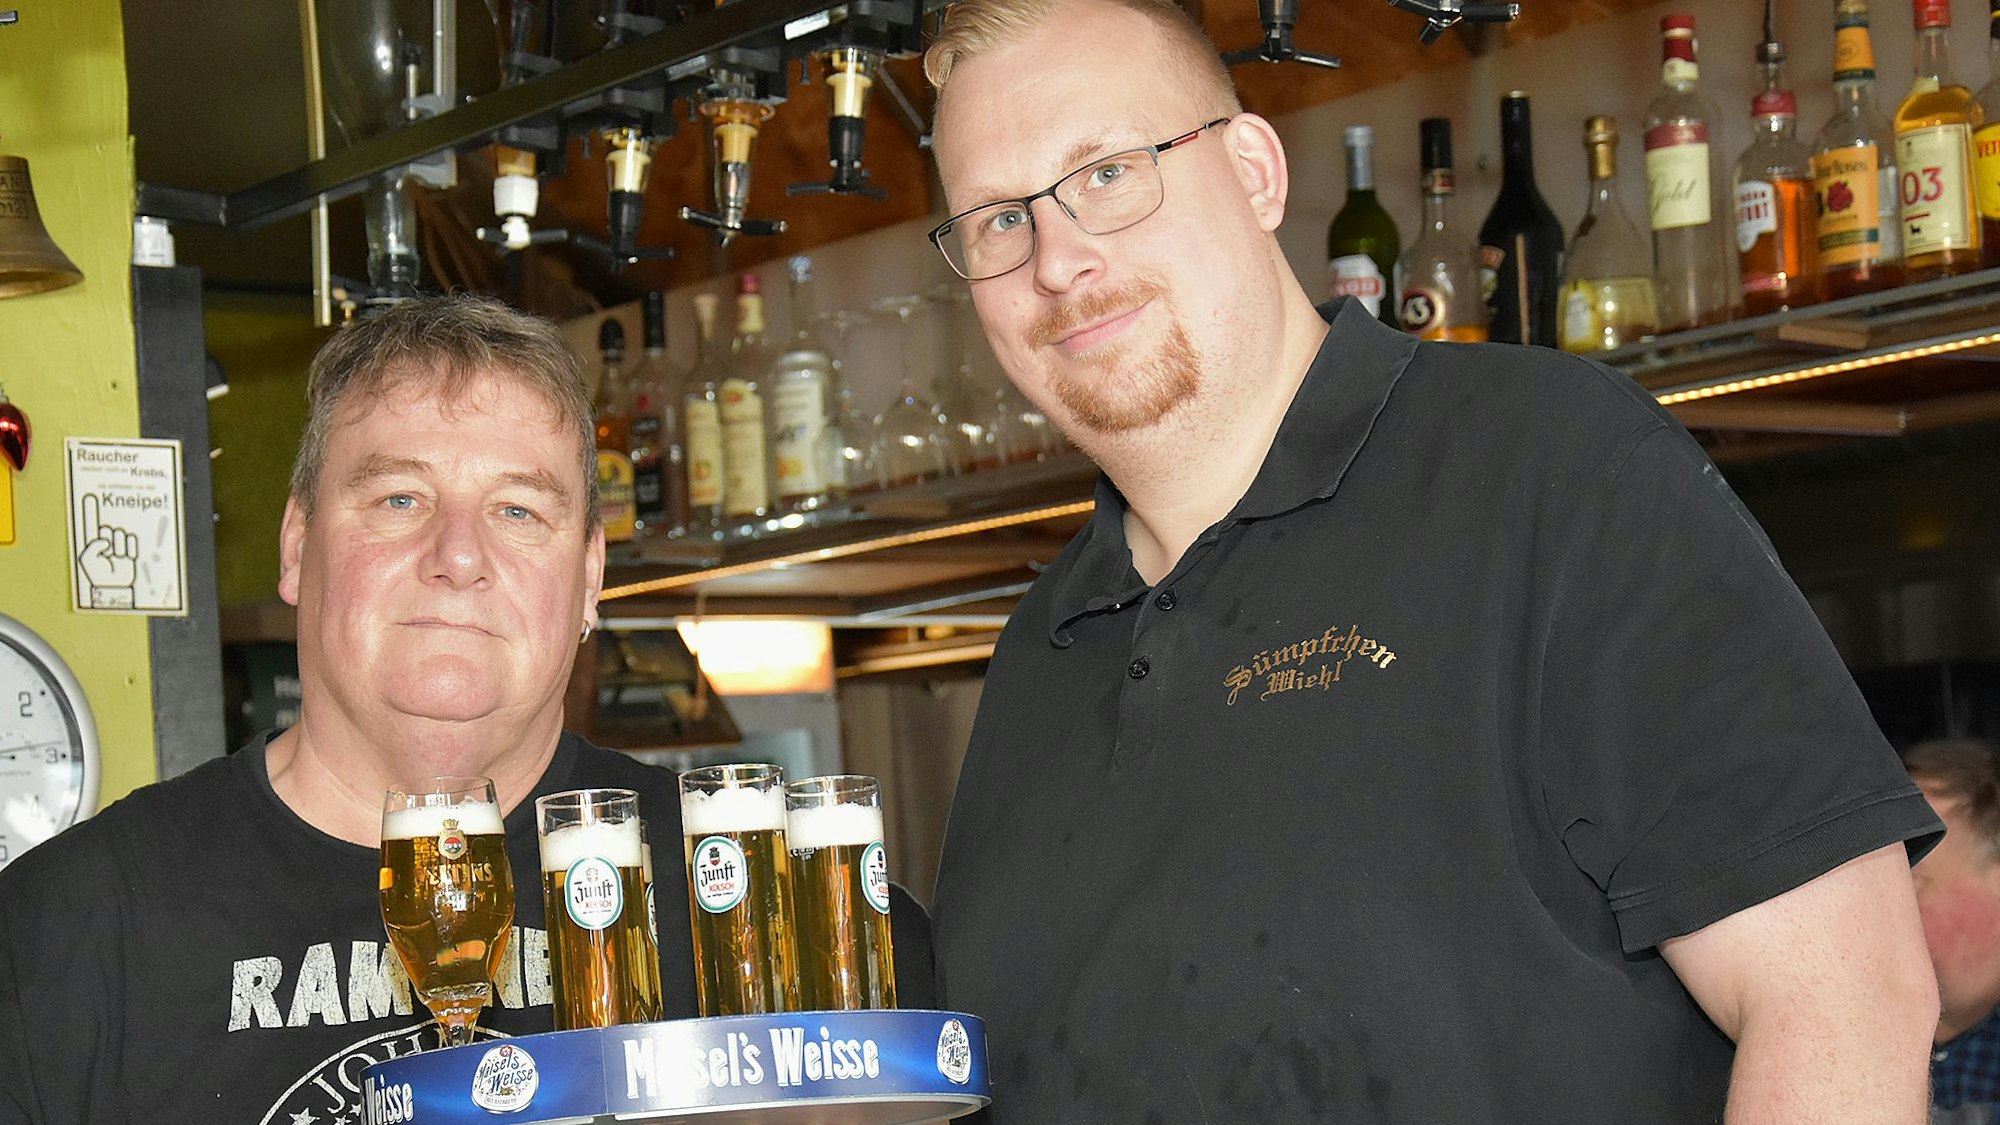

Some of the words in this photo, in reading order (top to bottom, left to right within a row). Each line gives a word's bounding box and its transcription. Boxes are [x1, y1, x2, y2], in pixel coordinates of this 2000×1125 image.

[76, 448, 138, 462] Raucher
[130, 466, 168, 479] Krebs,
[102, 492, 168, 511] Kneipe!
[1223, 624, 1397, 705] Sümpfchen
[1260, 660, 1344, 701] Wiehl
[18, 691, 33, 717] 2
[44, 746, 58, 764] 3
[228, 926, 556, 1032] RAMNE
[623, 1031, 764, 1099] Msel's
[768, 1026, 880, 1087] Weisse
[487, 1067, 534, 1093] Weisse
